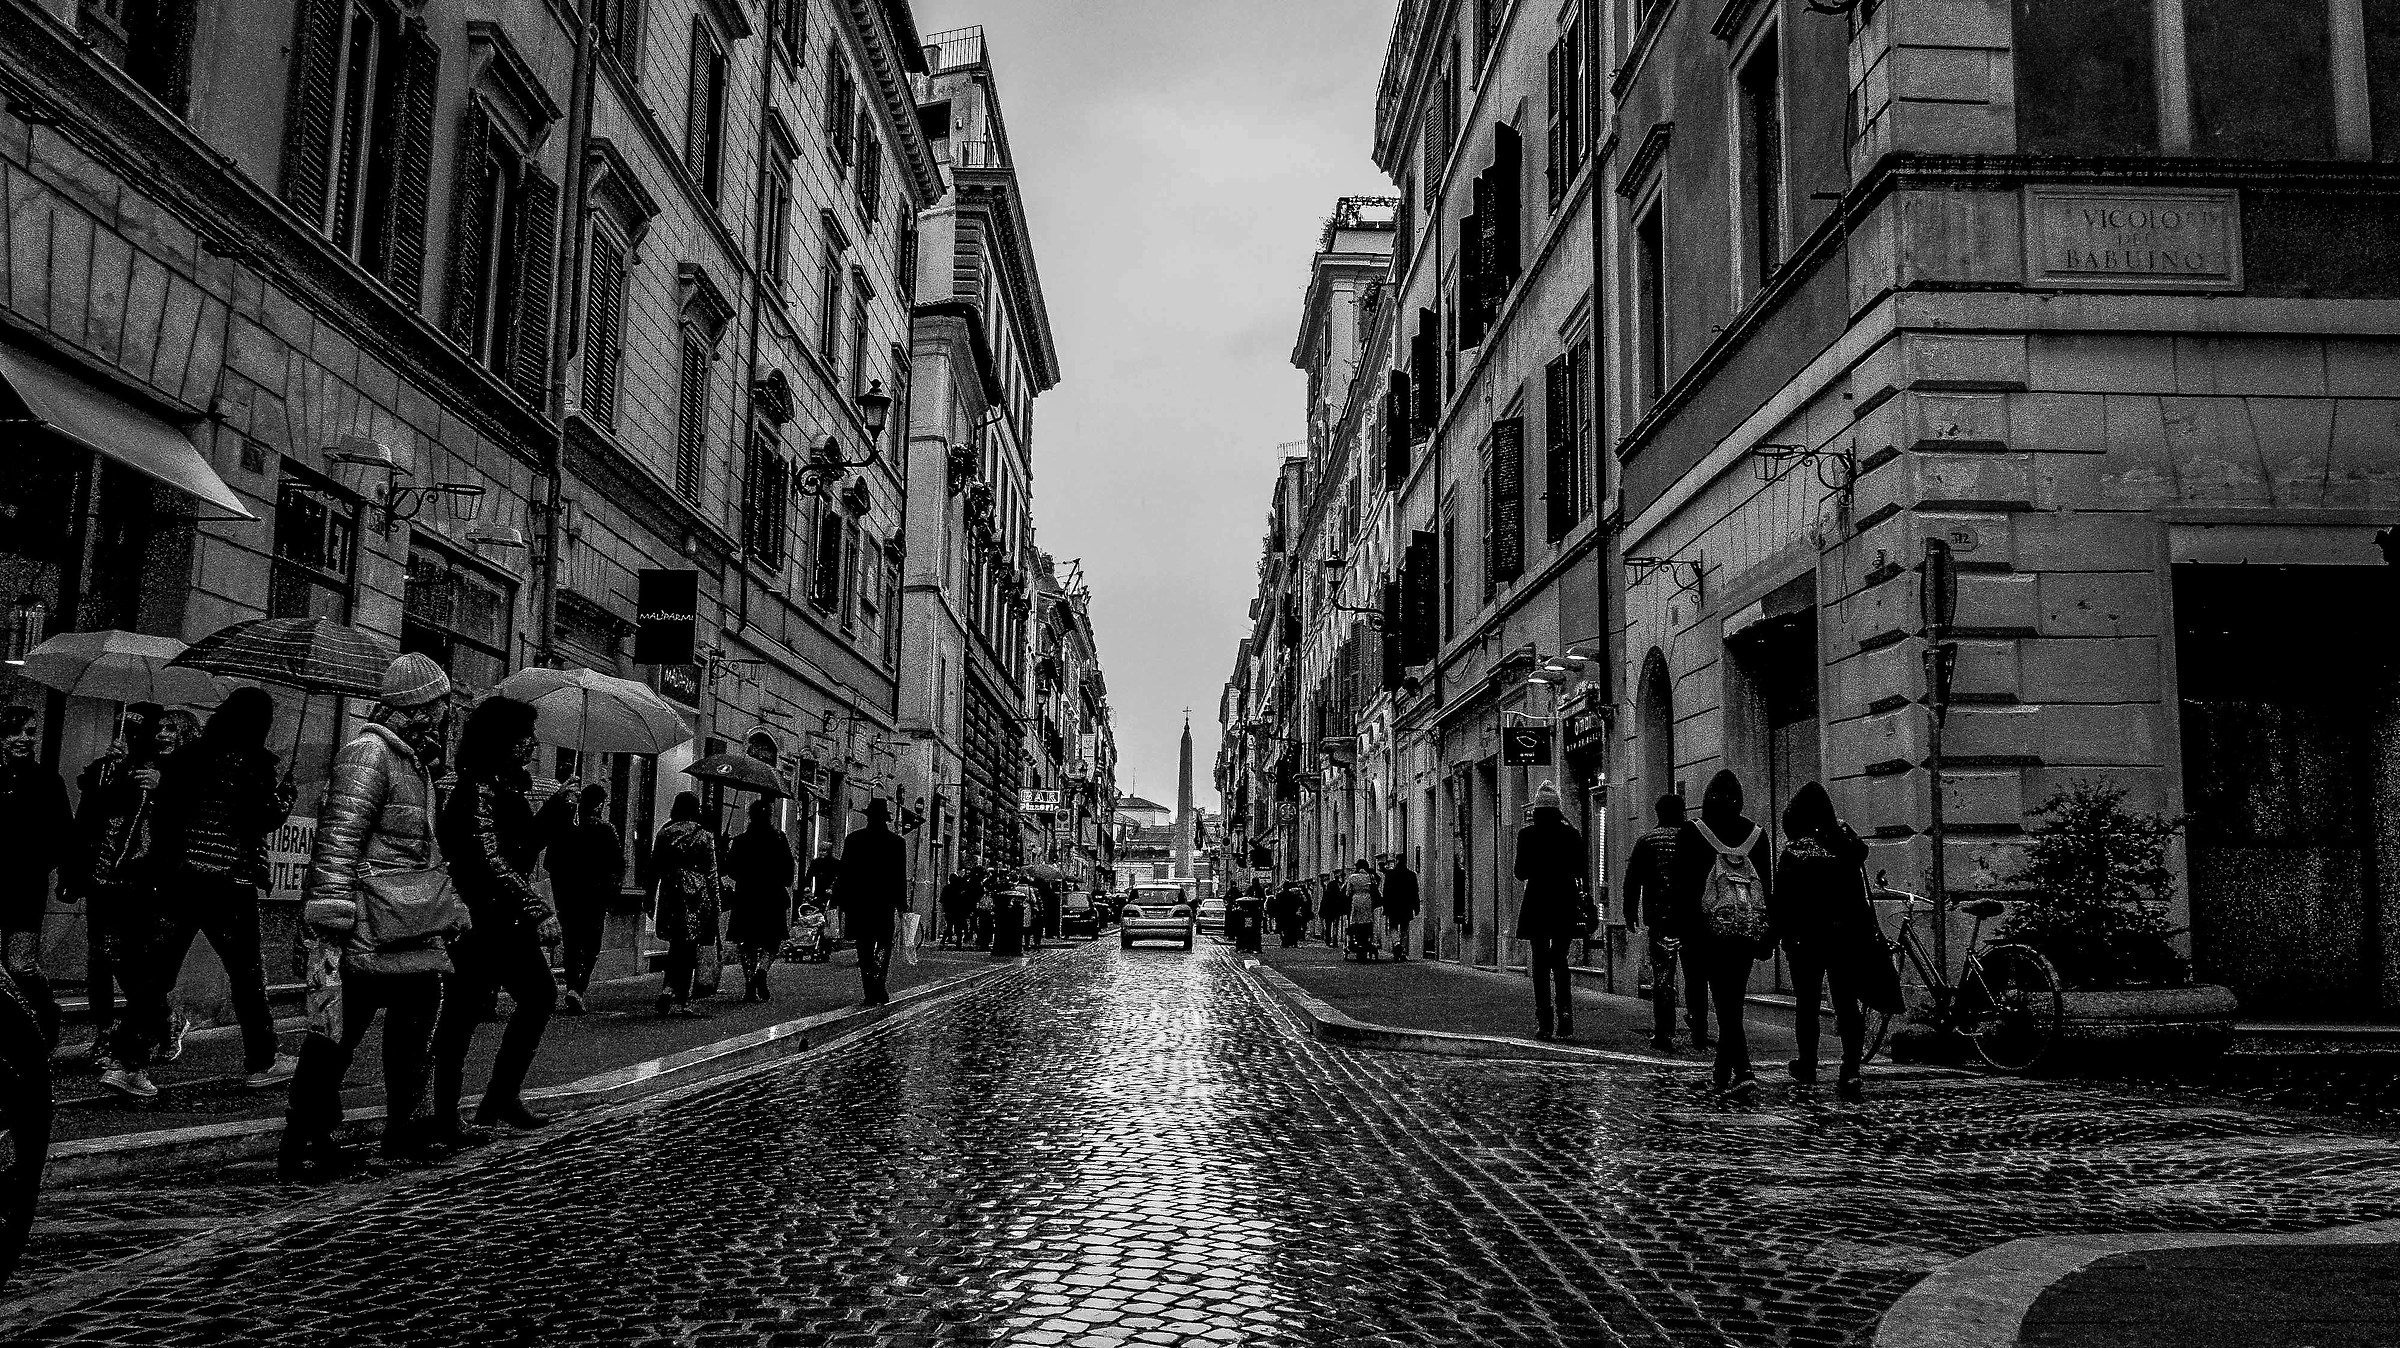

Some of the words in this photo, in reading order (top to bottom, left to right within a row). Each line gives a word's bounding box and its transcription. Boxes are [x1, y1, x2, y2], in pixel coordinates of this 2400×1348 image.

[2083, 208, 2181, 229] VICOLO
[2065, 249, 2204, 270] BABUINO
[1021, 791, 1057, 803] BAR
